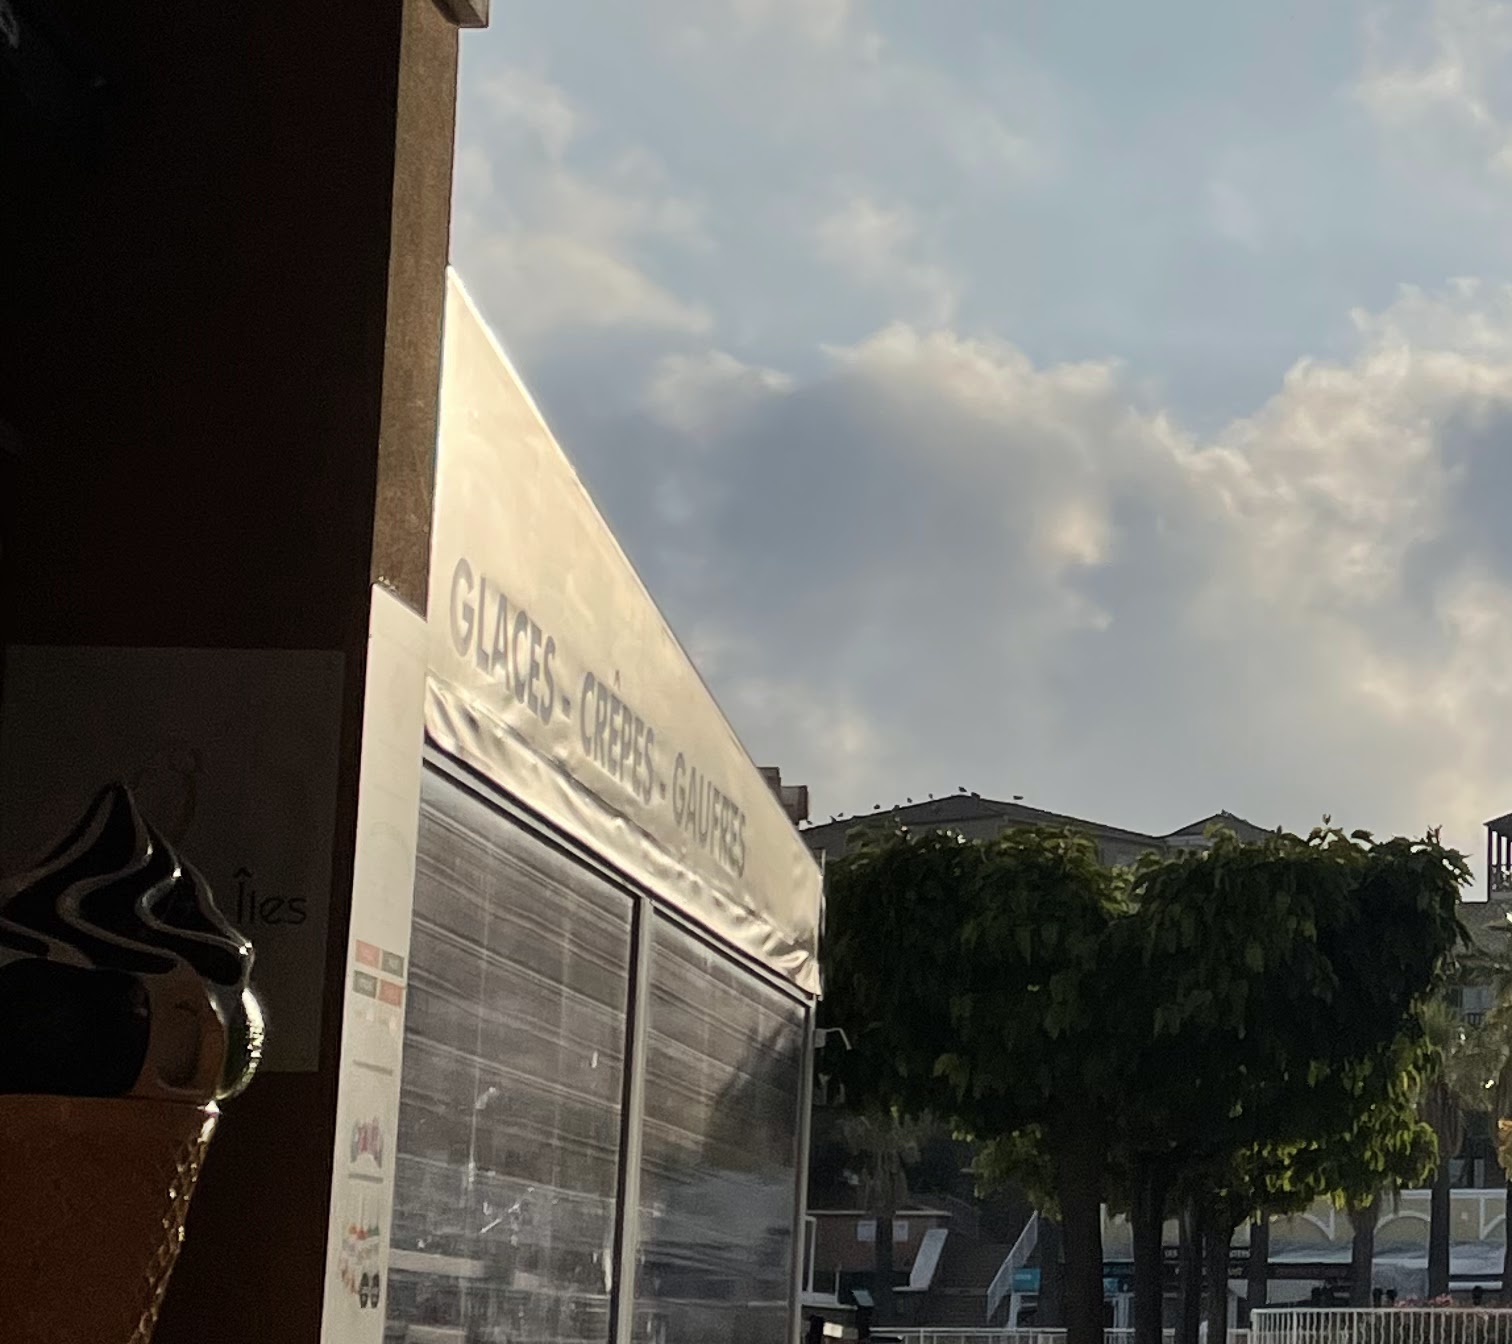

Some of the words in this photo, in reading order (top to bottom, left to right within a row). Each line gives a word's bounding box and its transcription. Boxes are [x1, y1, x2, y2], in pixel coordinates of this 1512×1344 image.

[449, 557, 556, 726] GLACES
[579, 668, 656, 806] CRÊPES
[672, 751, 748, 879] GAUFRES
